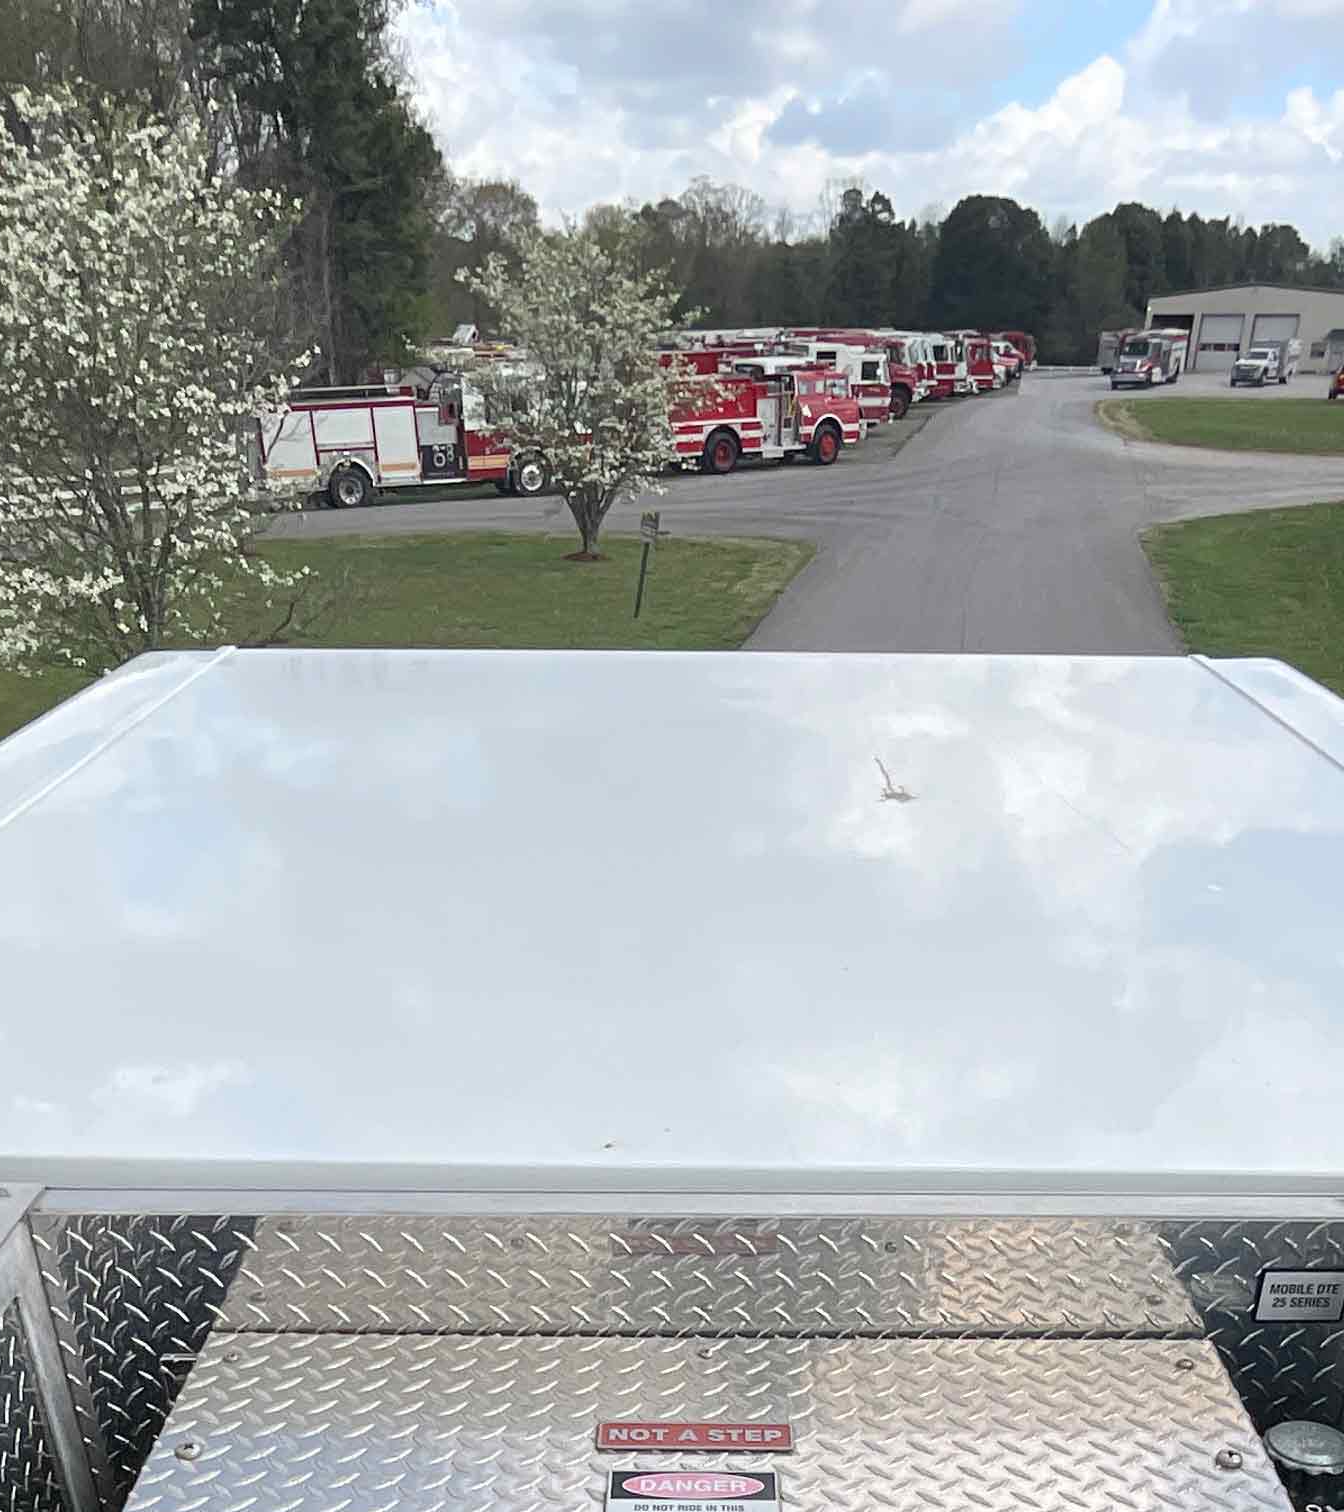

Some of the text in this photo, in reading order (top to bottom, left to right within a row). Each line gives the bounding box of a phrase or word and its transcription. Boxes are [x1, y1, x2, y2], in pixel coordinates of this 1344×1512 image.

[1269, 1283, 1341, 1295] MOBILE DTE
[1271, 1297, 1331, 1308] 25 SERIES
[608, 1428, 782, 1442] NOT A STEP
[639, 1478, 747, 1493] DANGER
[633, 1503, 745, 1512] DO NOT RIDE IN THIS
